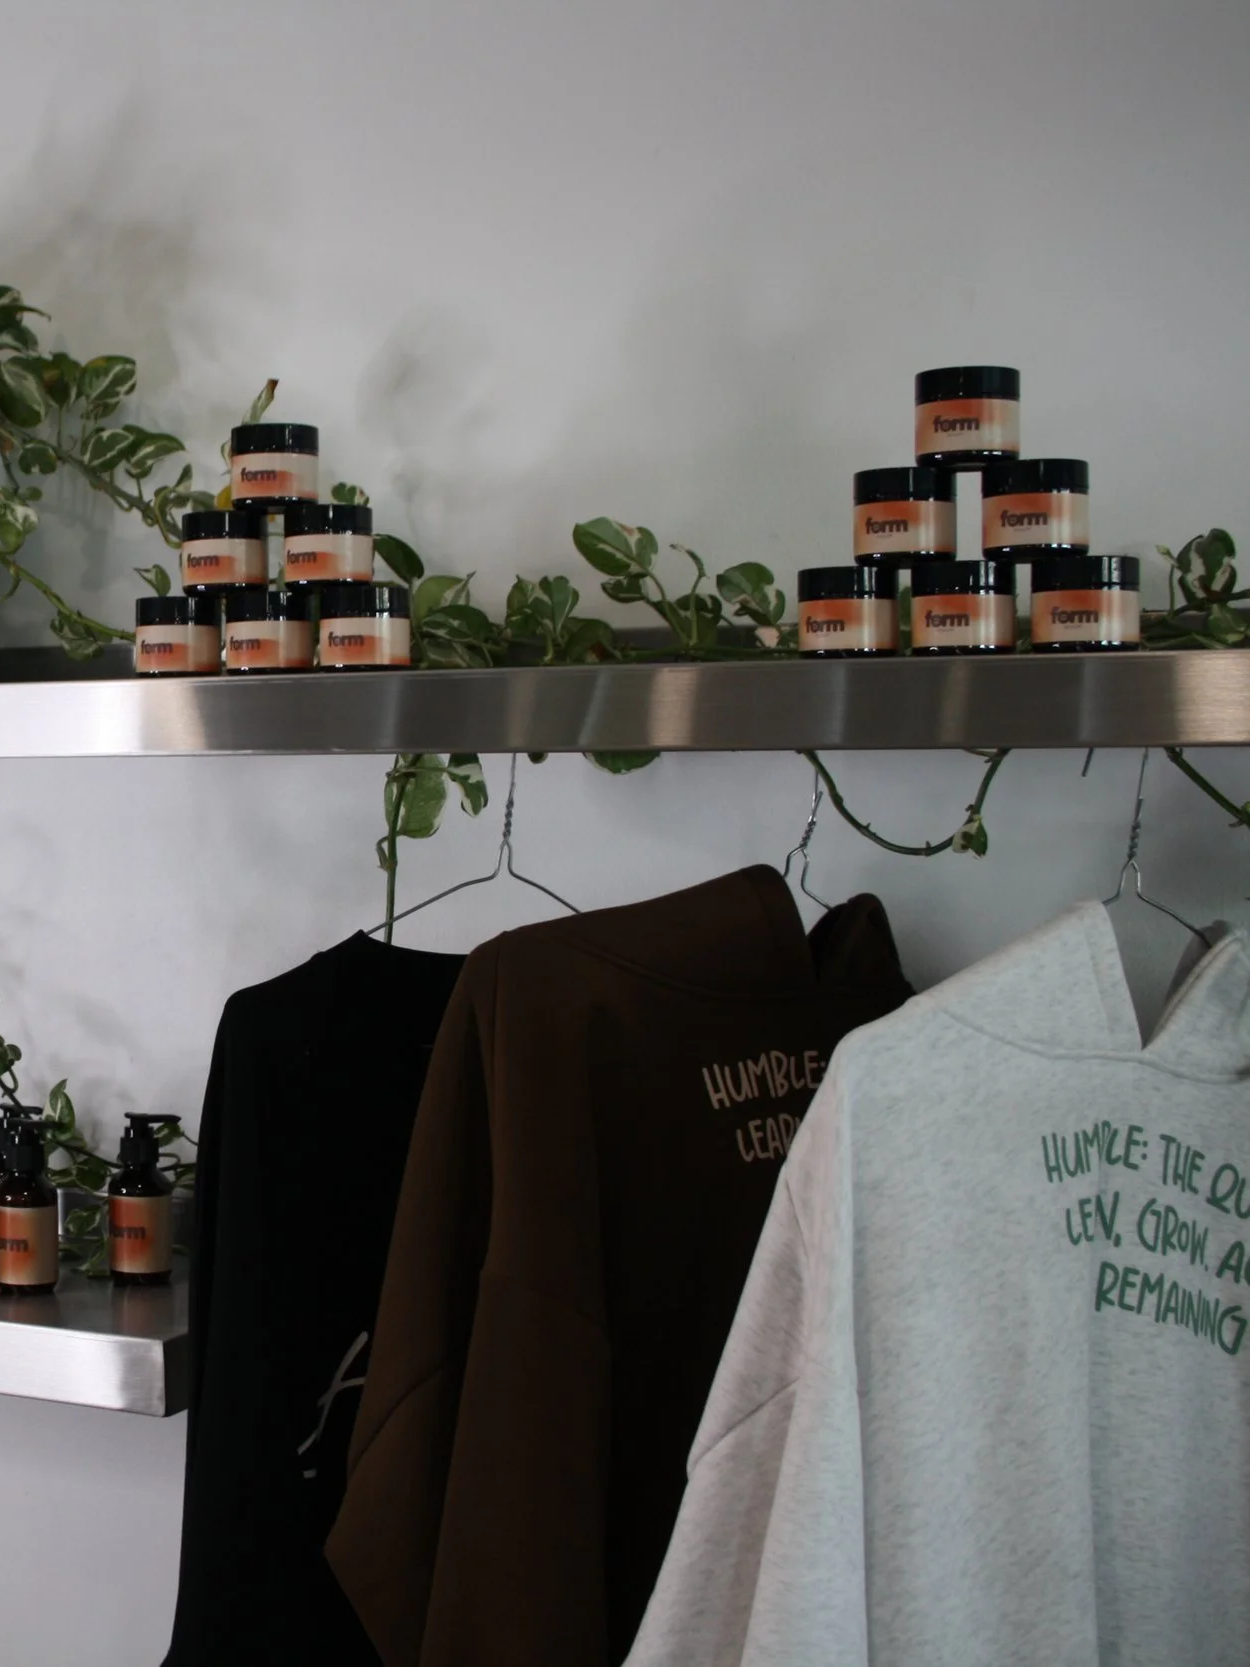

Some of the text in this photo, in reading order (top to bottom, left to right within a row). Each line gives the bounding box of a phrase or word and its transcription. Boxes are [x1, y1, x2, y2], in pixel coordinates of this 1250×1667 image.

[932, 415, 980, 433] form
[241, 467, 277, 482] form
[865, 517, 909, 534] form
[1000, 510, 1048, 528] form
[187, 553, 220, 568] form
[286, 550, 317, 565] form
[925, 610, 969, 627] form
[1050, 606, 1099, 624] form
[805, 616, 845, 633] form
[140, 639, 173, 655] form
[229, 636, 260, 651] form
[328, 631, 364, 647] form
[1159, 1134, 1205, 1194] THE
[1137, 1198, 1209, 1272] GROW.
[1216, 1241, 1250, 1286] A
[1095, 1261, 1247, 1355] REMAINING
